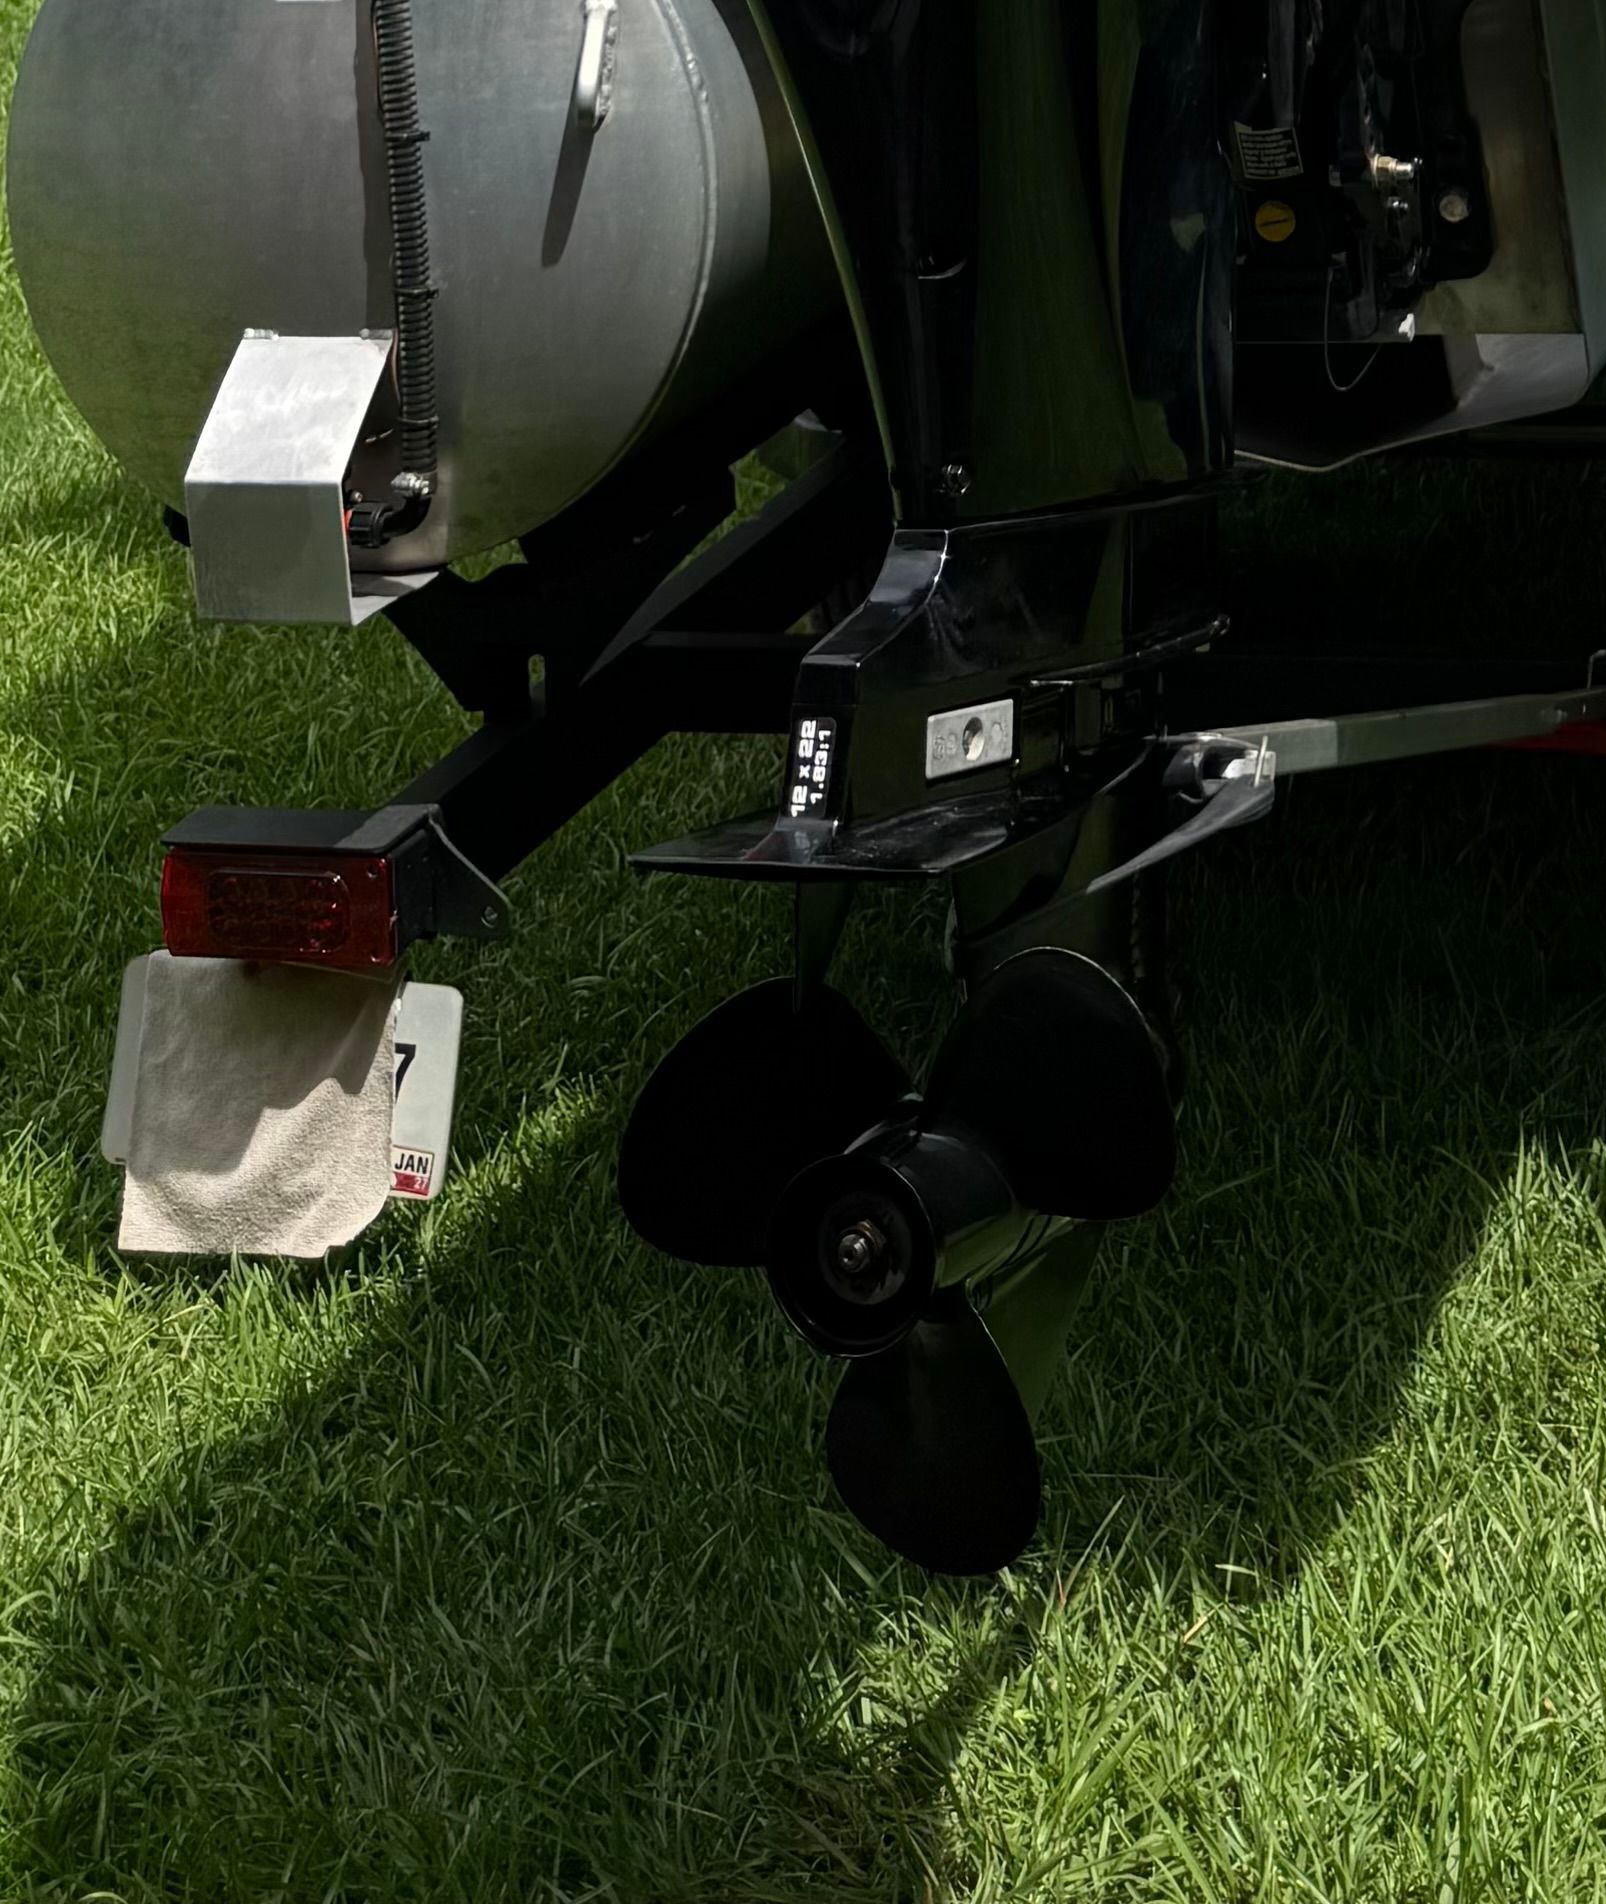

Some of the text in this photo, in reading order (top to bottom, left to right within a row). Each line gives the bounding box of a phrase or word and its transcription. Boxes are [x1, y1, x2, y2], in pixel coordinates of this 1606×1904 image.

[798, 720, 817, 759] 22
[809, 730, 831, 805] 1.83:1
[791, 785, 808, 818] 12
[394, 1153, 429, 1175] JAN
